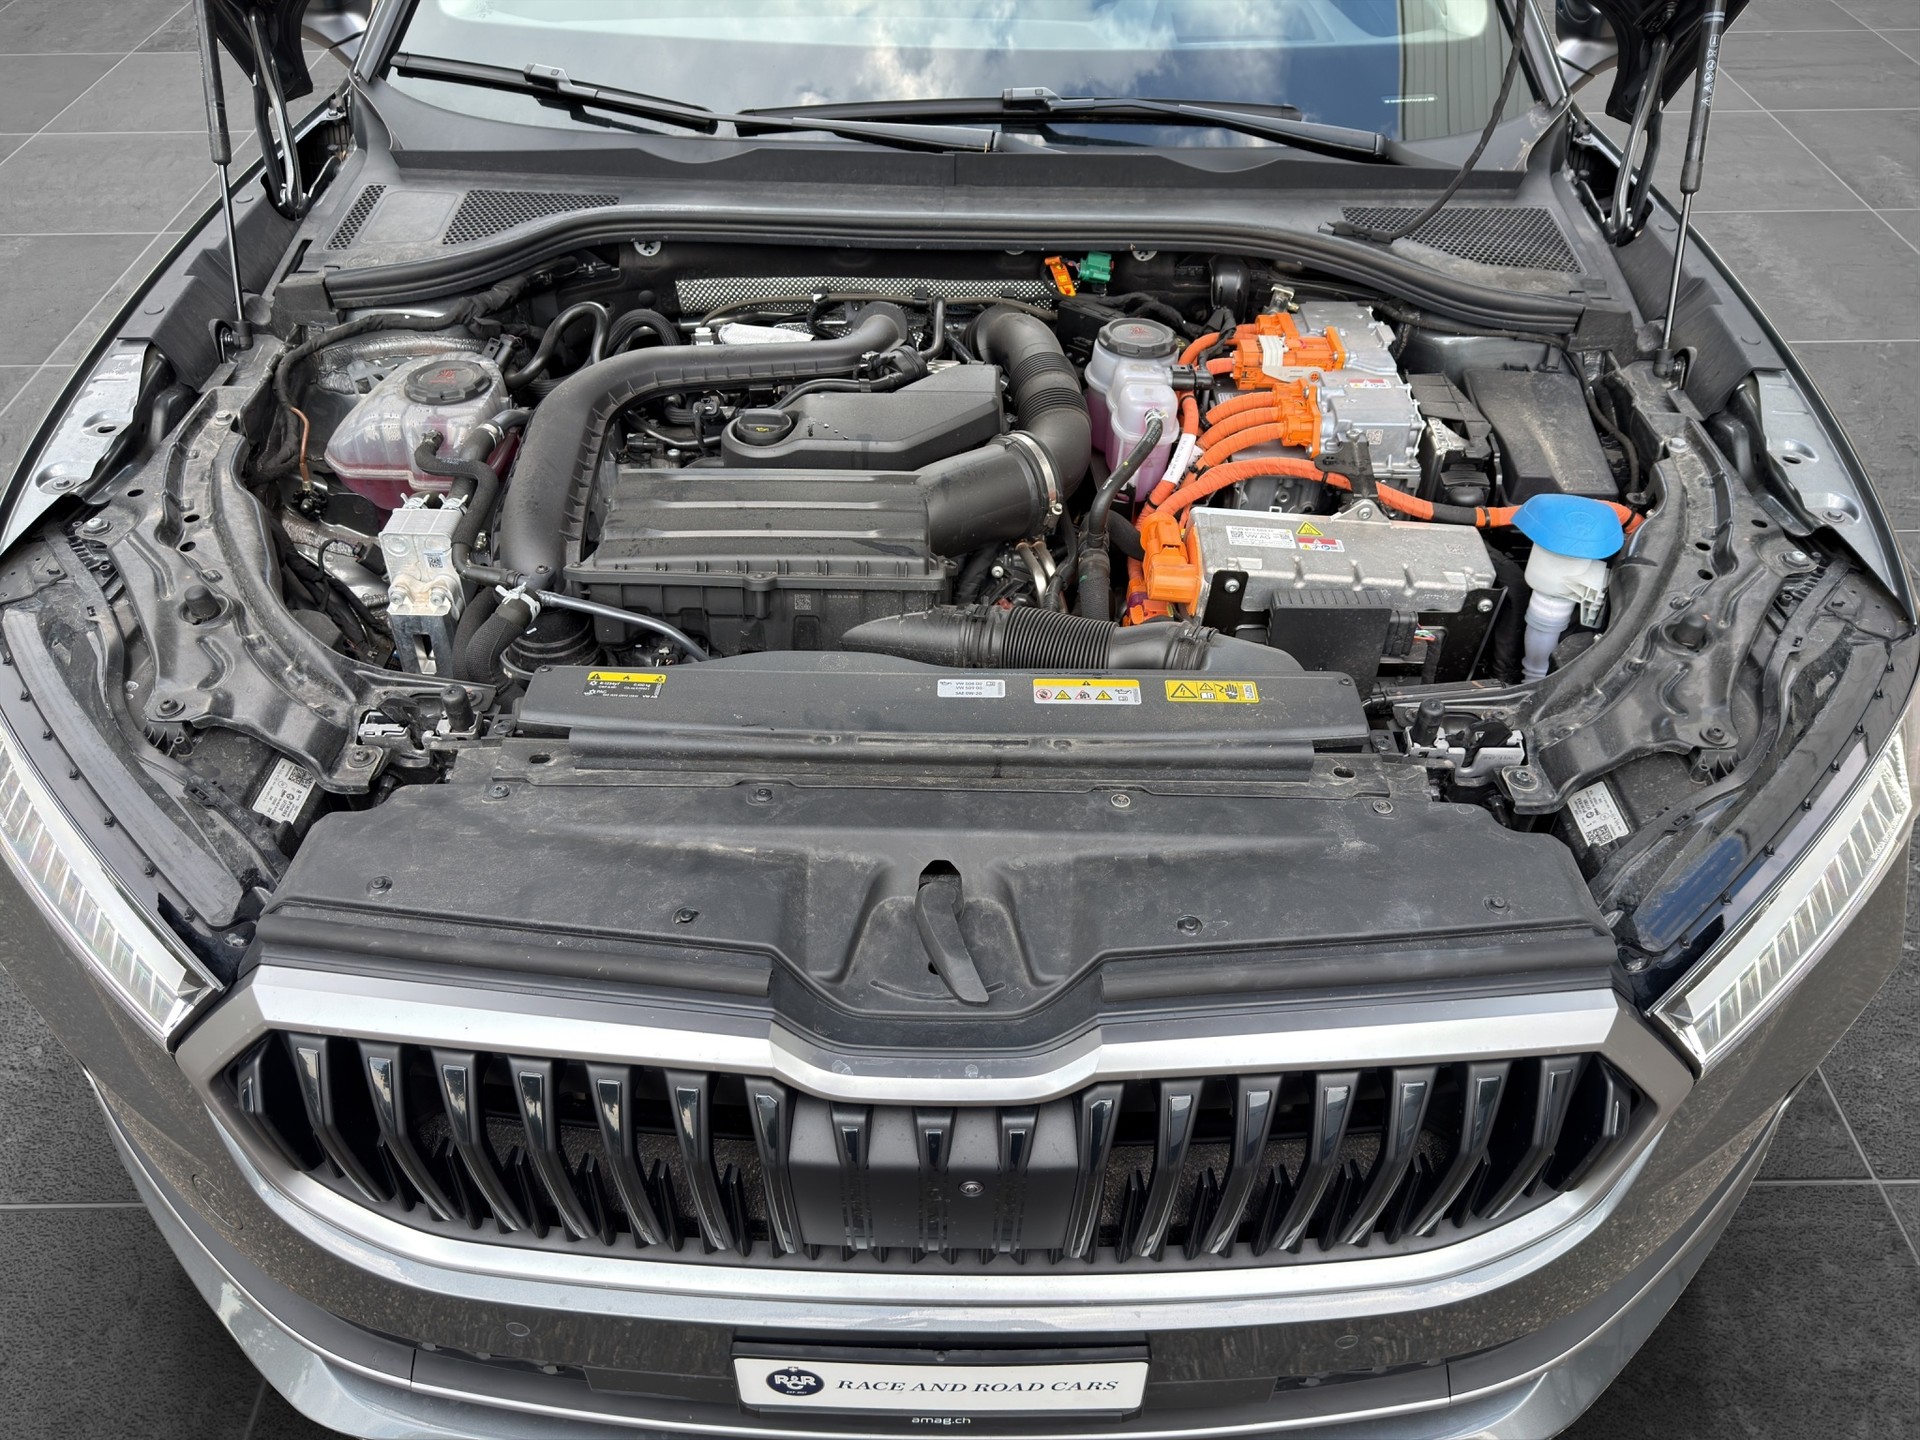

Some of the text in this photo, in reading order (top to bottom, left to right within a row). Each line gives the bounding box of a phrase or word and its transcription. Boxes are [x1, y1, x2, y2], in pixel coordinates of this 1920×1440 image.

[835, 1380, 1119, 1392] RACE AND ROAD CARS
[911, 1416, 971, 1425] amag.ch
